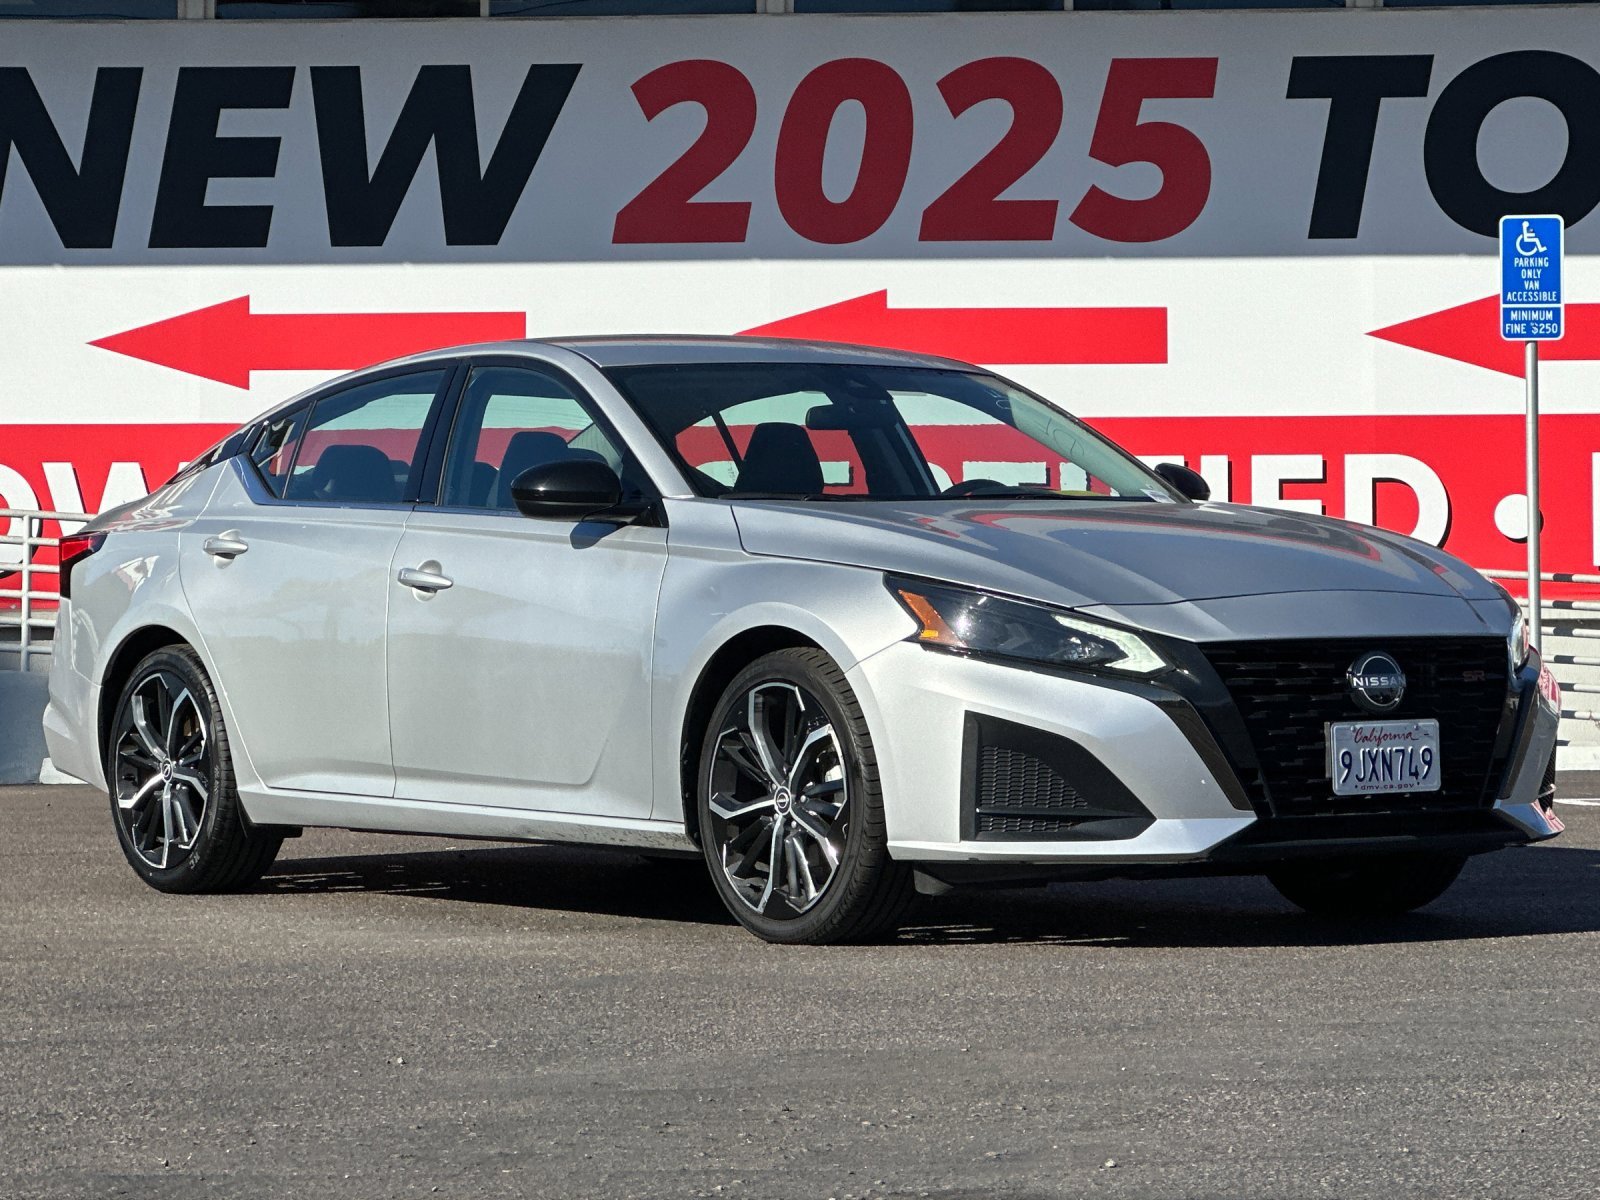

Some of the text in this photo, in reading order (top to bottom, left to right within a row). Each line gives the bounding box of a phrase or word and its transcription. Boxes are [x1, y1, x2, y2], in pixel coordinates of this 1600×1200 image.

[0, 63, 583, 248] NEW
[611, 56, 1219, 244] 2025
[1513, 257, 1549, 268] PARKING
[1521, 268, 1542, 279] ONLY
[1524, 280, 1540, 290] VAN
[1506, 291, 1557, 302] ACCESSIBLE
[1510, 310, 1553, 321] MINIMUM
[1505, 322, 1558, 335] FINE $250
[1462, 670, 1486, 682] SR
[1353, 676, 1406, 688] NISSAN
[1354, 727, 1419, 747] California
[1340, 746, 1433, 784] 9JXN749
[1360, 782, 1415, 791] dmv.ca.gov
